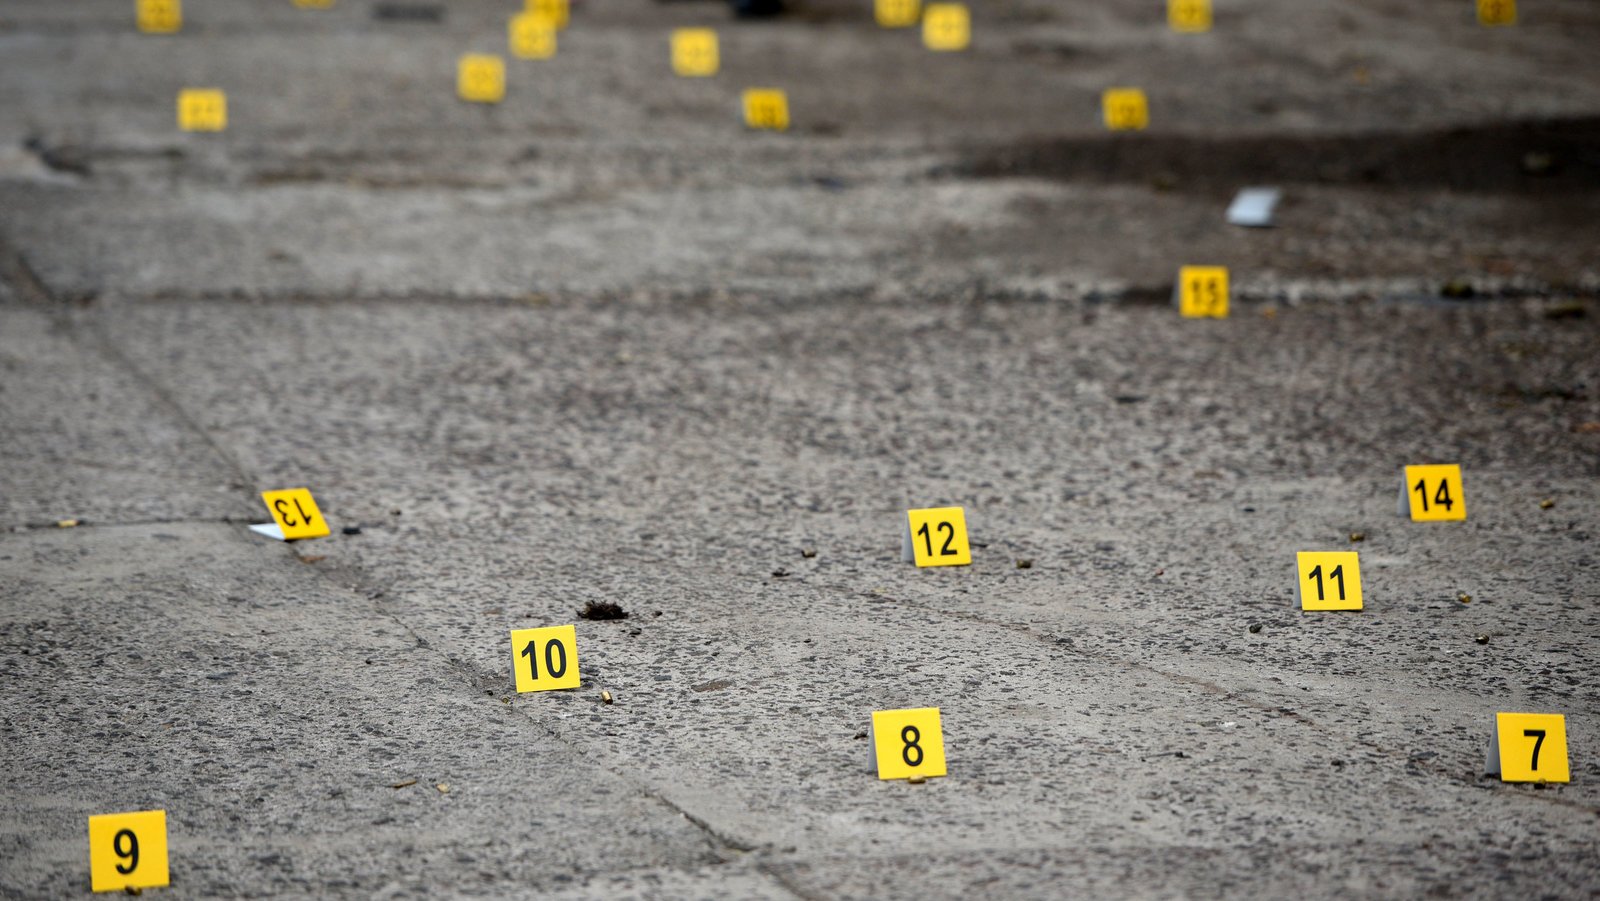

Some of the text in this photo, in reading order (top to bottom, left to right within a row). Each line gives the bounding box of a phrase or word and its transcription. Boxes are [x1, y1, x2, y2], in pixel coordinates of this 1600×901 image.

[274, 498, 312, 527] 13
[1414, 479, 1453, 512] 14
[917, 522, 957, 556] 12
[1308, 565, 1345, 600] 11
[521, 638, 567, 680] 10
[901, 725, 924, 767] 8
[1523, 730, 1547, 771] 7
[113, 828, 139, 875] 9
